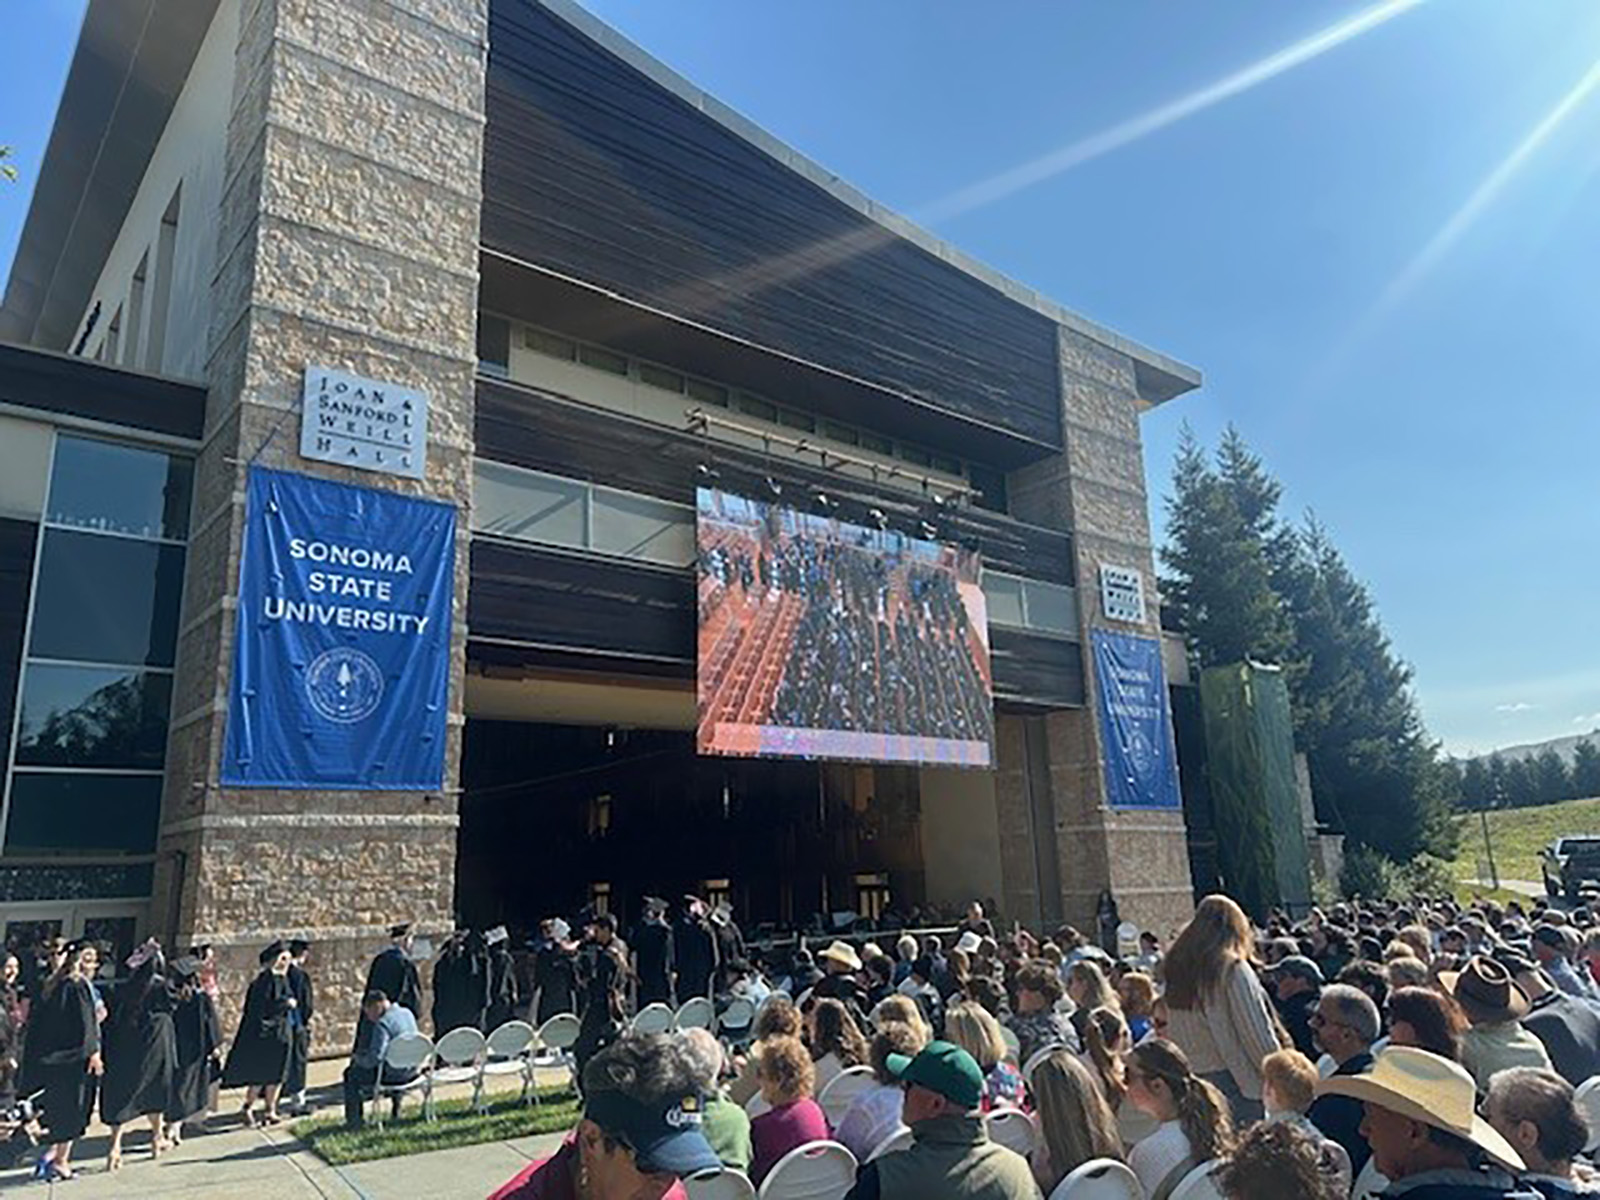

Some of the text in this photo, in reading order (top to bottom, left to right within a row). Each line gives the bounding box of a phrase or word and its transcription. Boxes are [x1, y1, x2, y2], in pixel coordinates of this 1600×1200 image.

[319, 394, 398, 424] SANFORD
[319, 413, 412, 445] WEILL
[317, 437, 411, 468] HALL
[289, 538, 413, 574] SONOMA
[309, 572, 392, 601] STATE
[264, 597, 429, 635] UNIVERSITY
